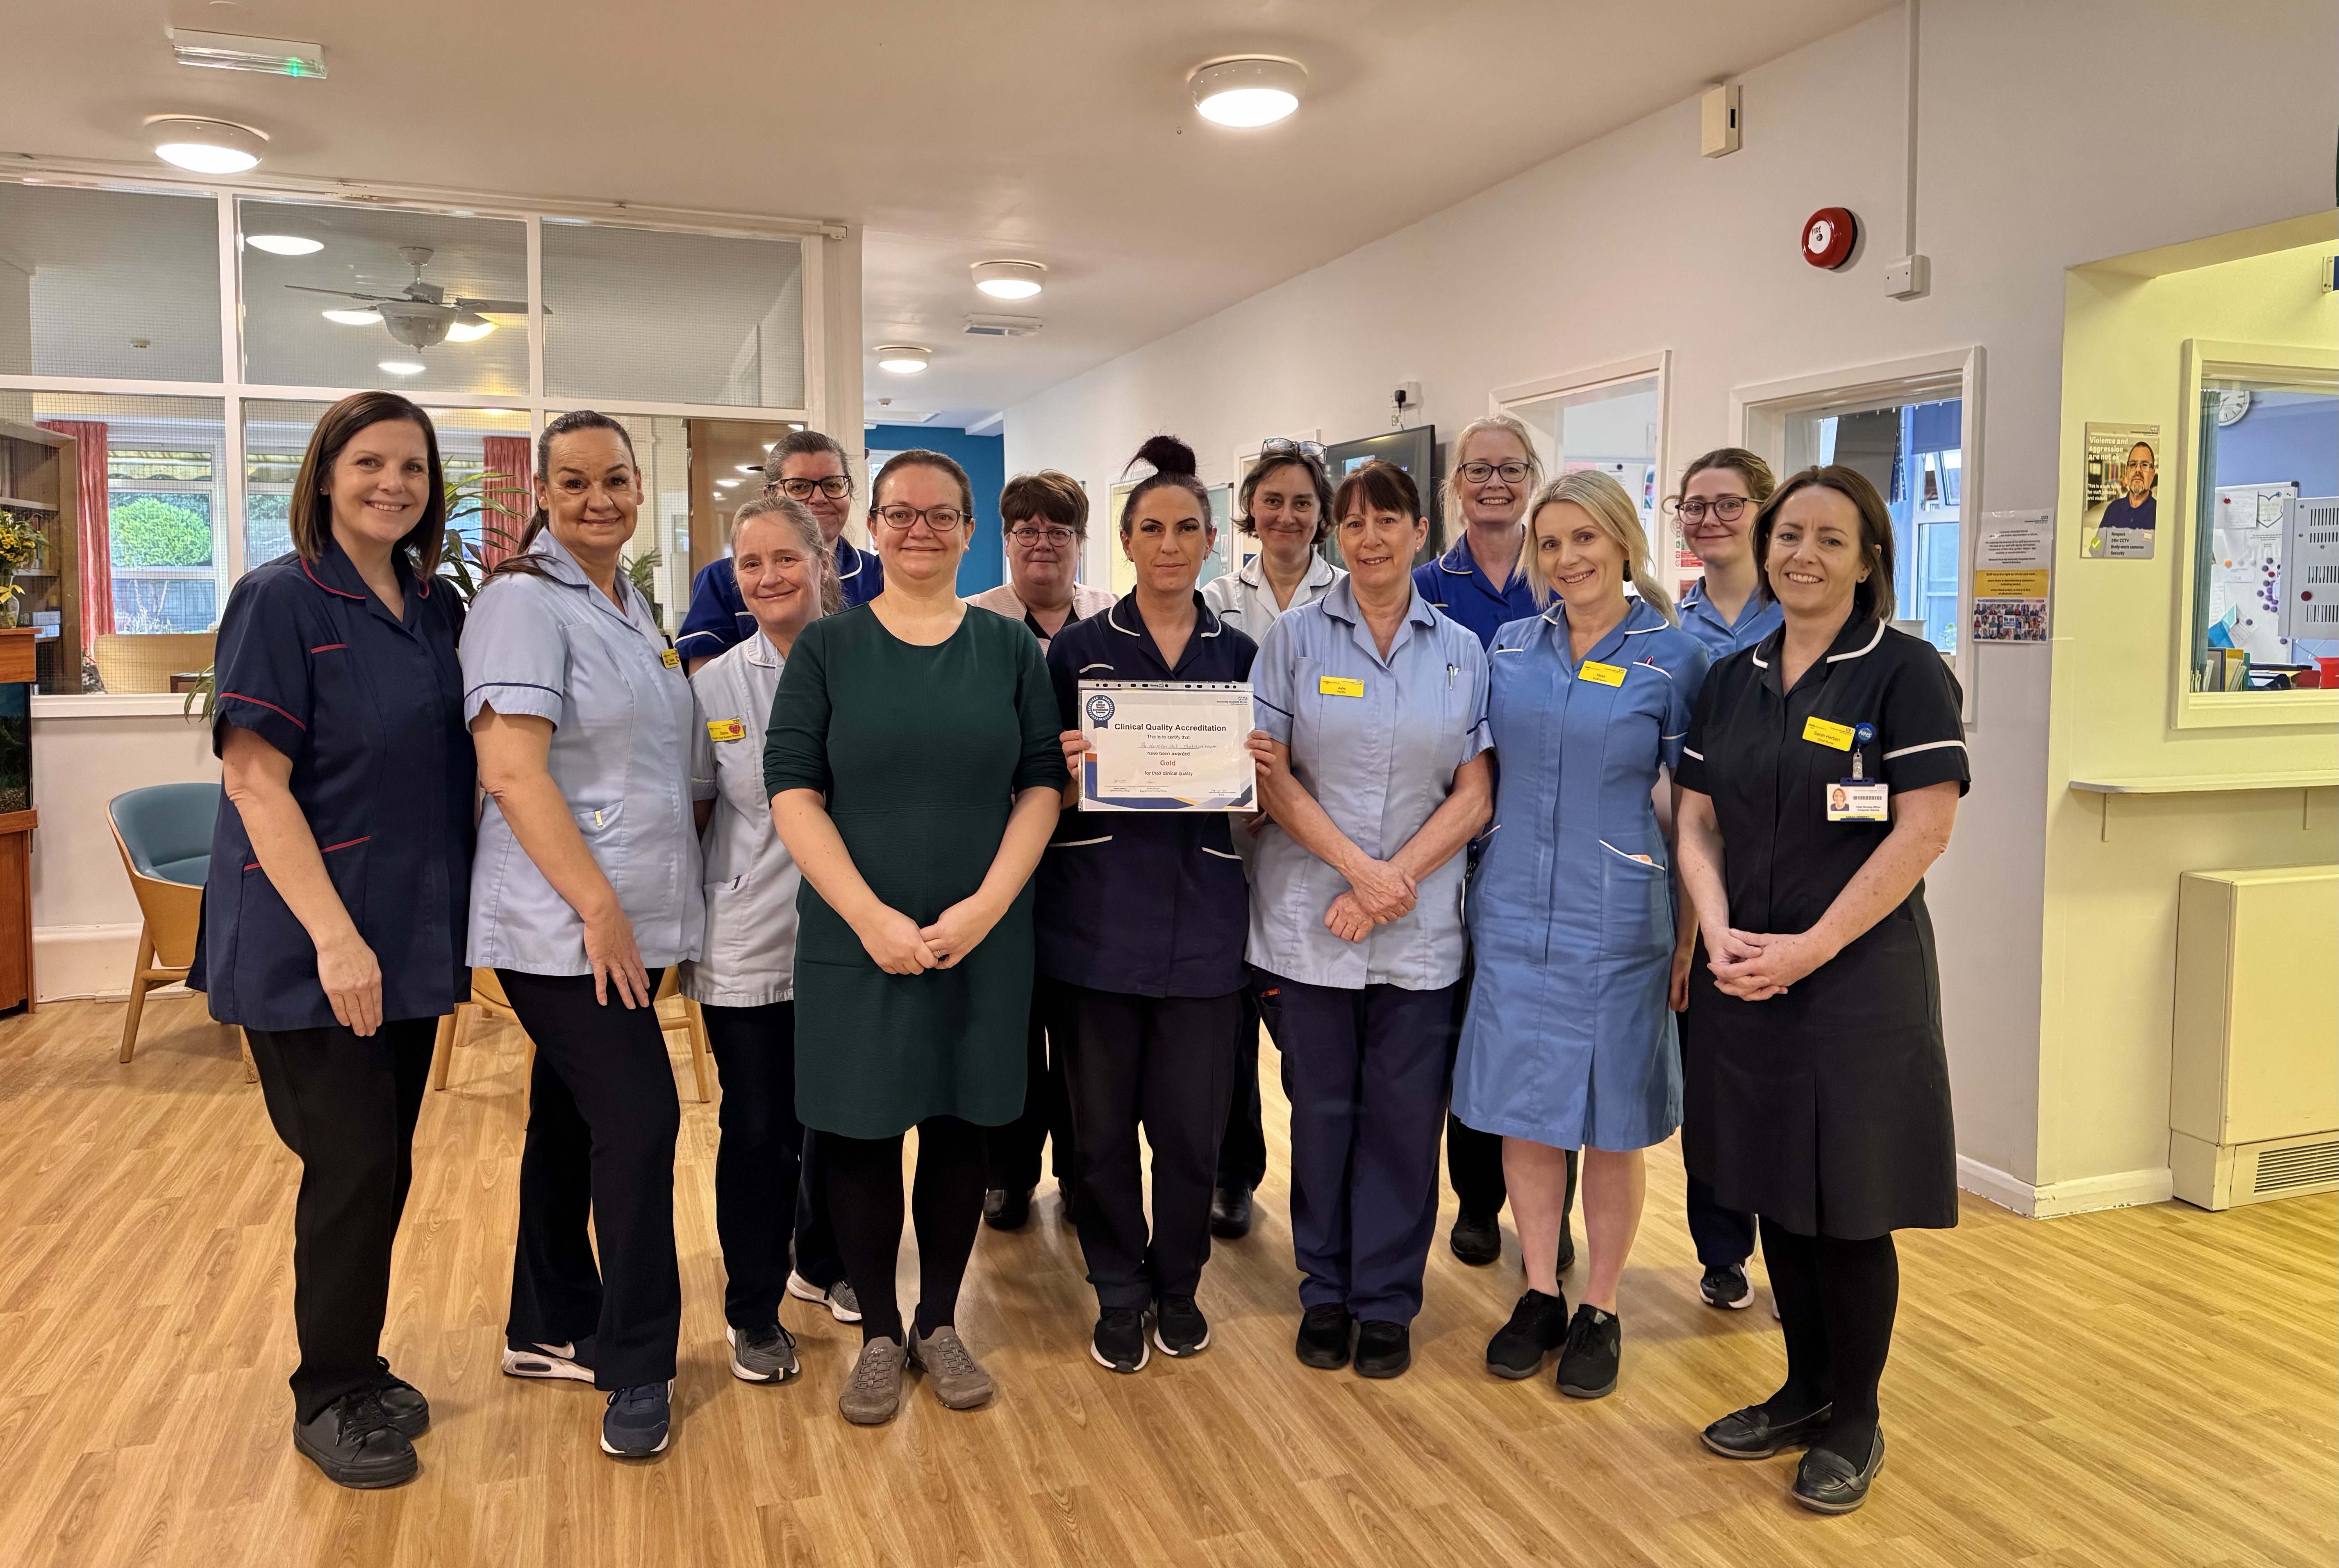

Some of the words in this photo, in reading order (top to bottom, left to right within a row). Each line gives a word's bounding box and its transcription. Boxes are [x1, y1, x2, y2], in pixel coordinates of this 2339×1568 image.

[1812, 226, 1821, 235] FIRE
[2089, 436, 2116, 444] Violence
[2089, 445, 2123, 453] aggression
[1146, 724, 1173, 732] Quality
[1858, 730, 1873, 738] NHS
